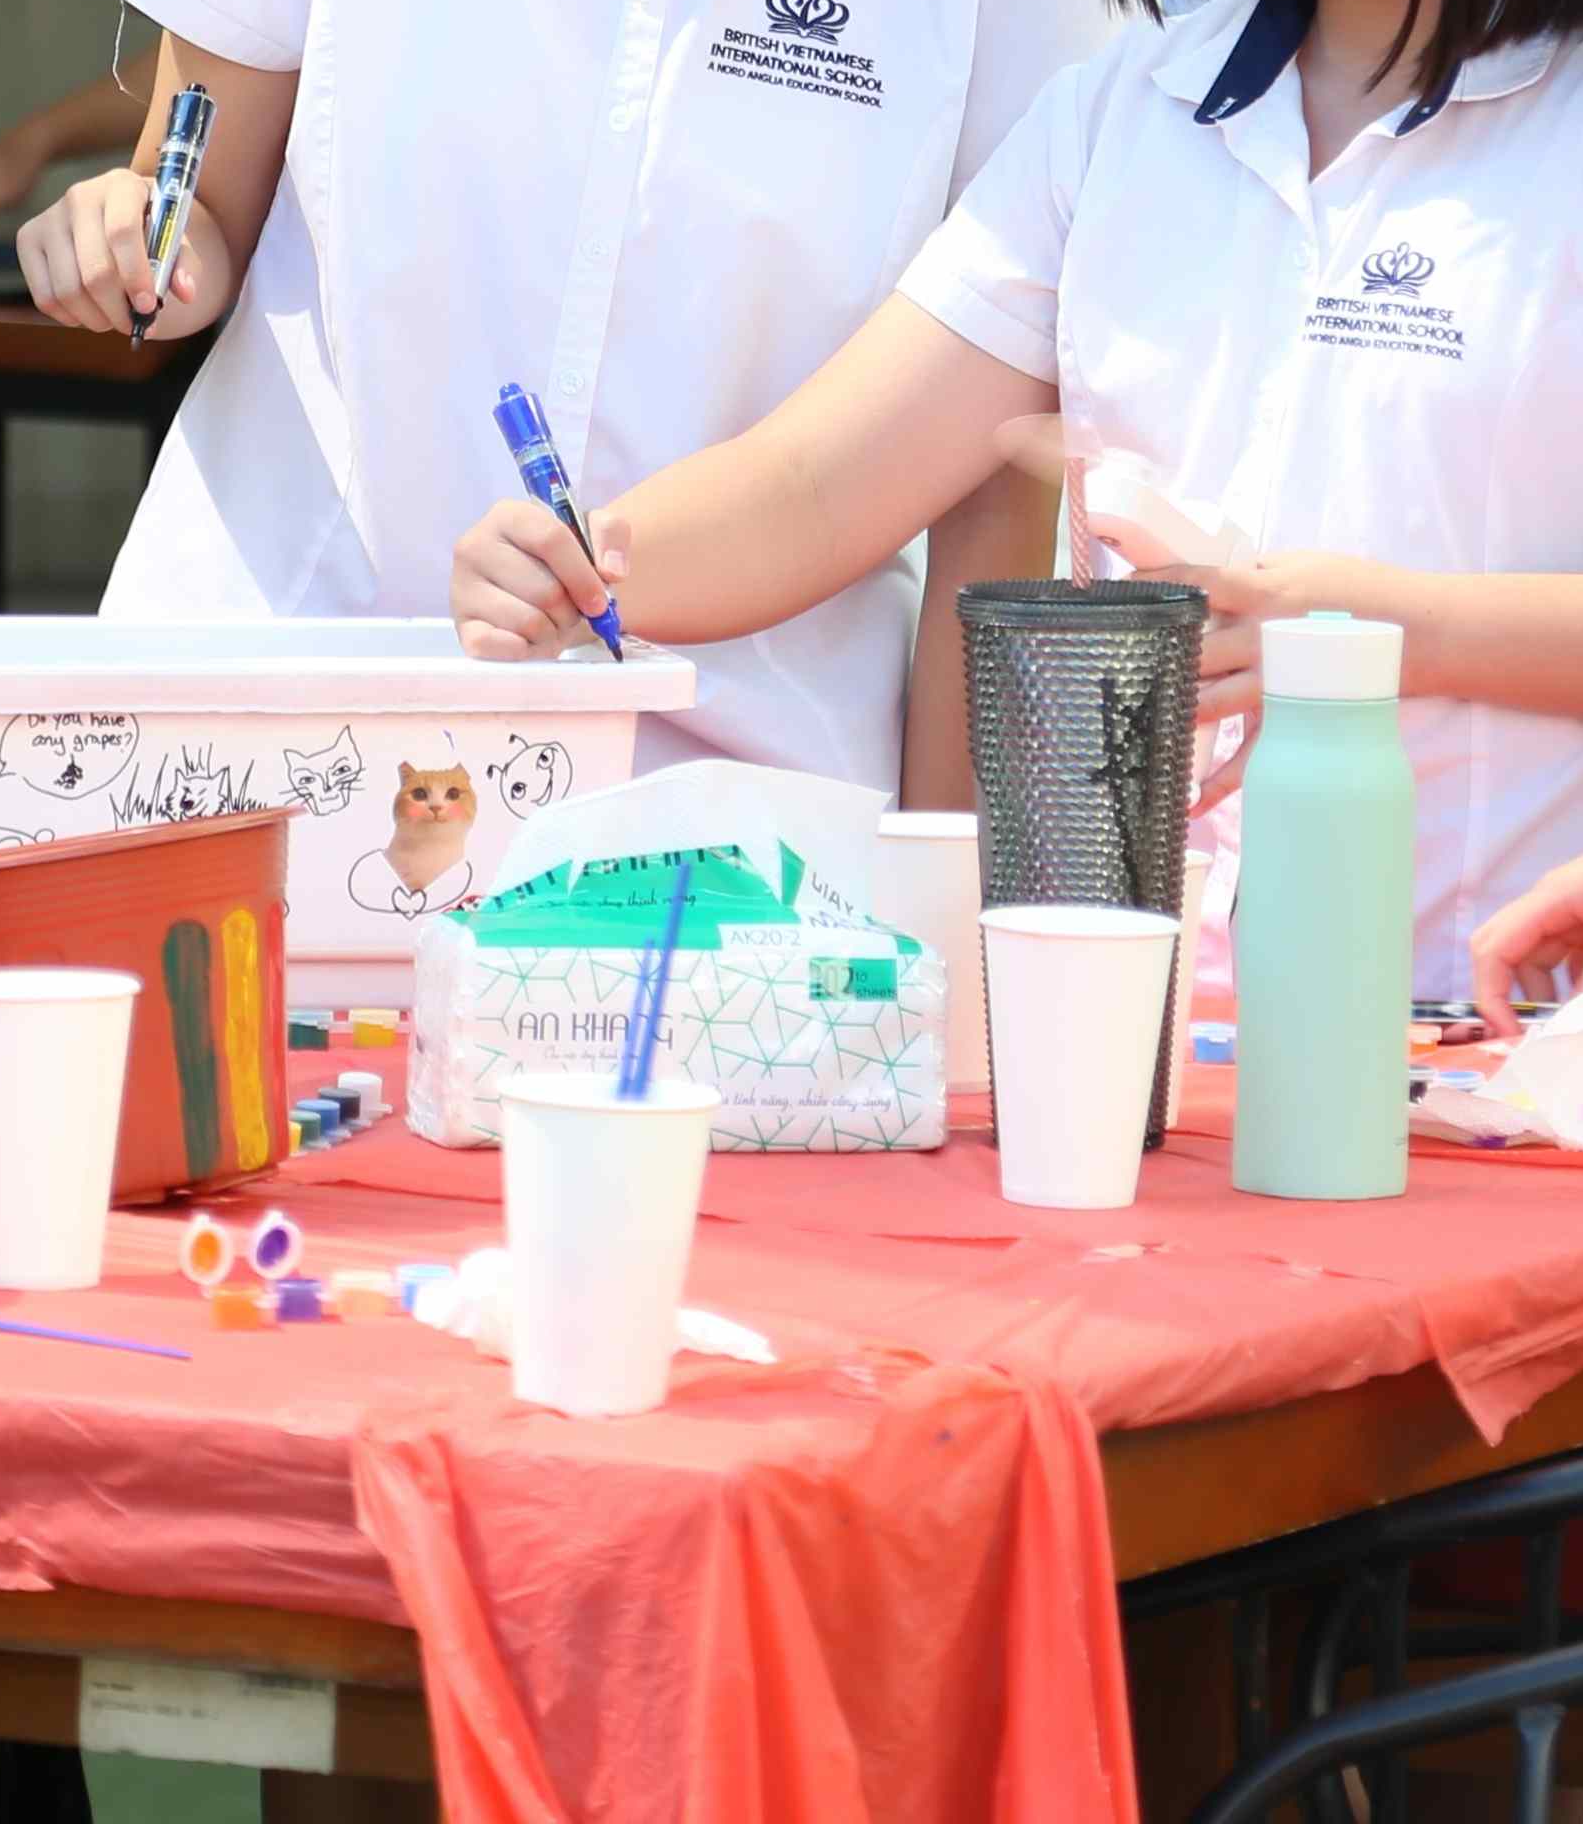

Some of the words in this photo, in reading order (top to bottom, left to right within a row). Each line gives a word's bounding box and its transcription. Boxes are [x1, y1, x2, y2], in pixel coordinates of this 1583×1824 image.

[723, 27, 780, 54] BRITISH
[782, 42, 875, 73] VIETNAMESE
[710, 43, 822, 80] INTERNATIONAL
[824, 67, 885, 93] SCHOOL
[707, 62, 715, 71] A
[716, 63, 746, 78] NORD
[747, 69, 784, 87] ANGLIA
[786, 78, 842, 98] EDUCATION
[844, 90, 883, 108] SCHOOL
[1316, 296, 1370, 314] BRITISH
[1374, 302, 1455, 324] VIETNAMESE
[1305, 315, 1405, 336] INTERNATIONAL
[1407, 323, 1466, 345] SCHOOL
[1424, 343, 1463, 360] SCHOOL
[52, 713, 82, 730] you
[90, 712, 126, 727] have
[32, 733, 66, 756] any
[73, 732, 134, 753] grapes?
[518, 1012, 560, 1041] AN
